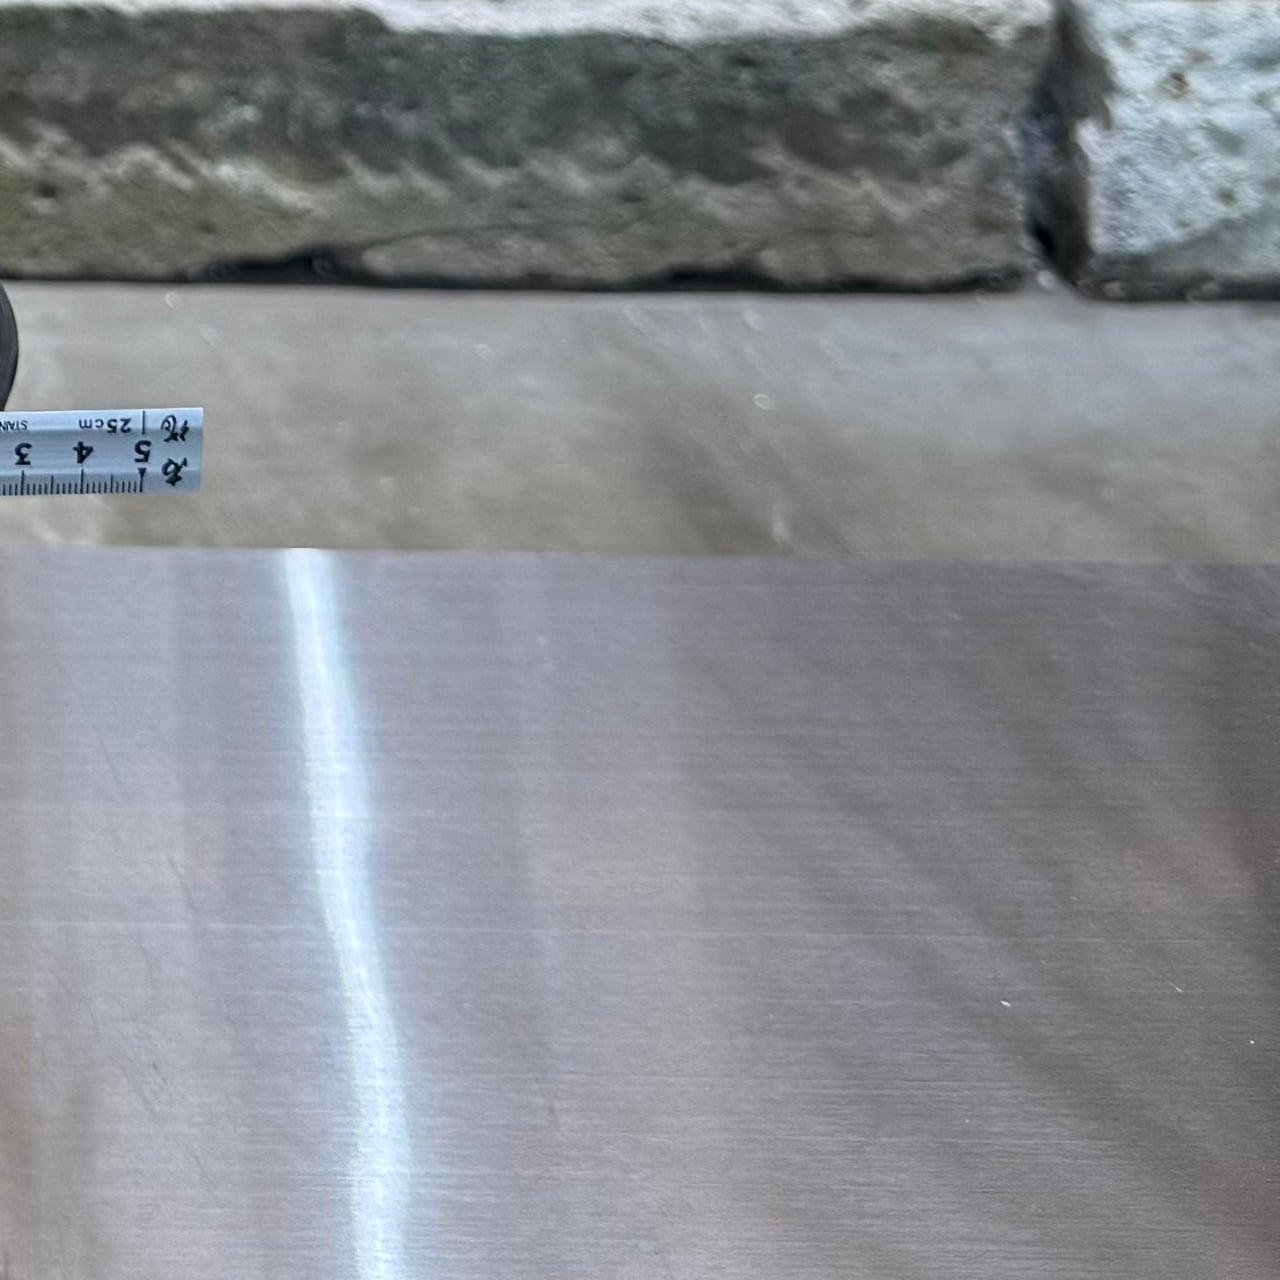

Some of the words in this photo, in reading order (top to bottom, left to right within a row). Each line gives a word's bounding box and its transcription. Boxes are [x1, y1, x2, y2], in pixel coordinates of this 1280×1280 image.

[79, 417, 132, 432] 25cm
[14, 443, 32, 465] 3
[73, 441, 94, 464] 4
[134, 440, 152, 463] 5
